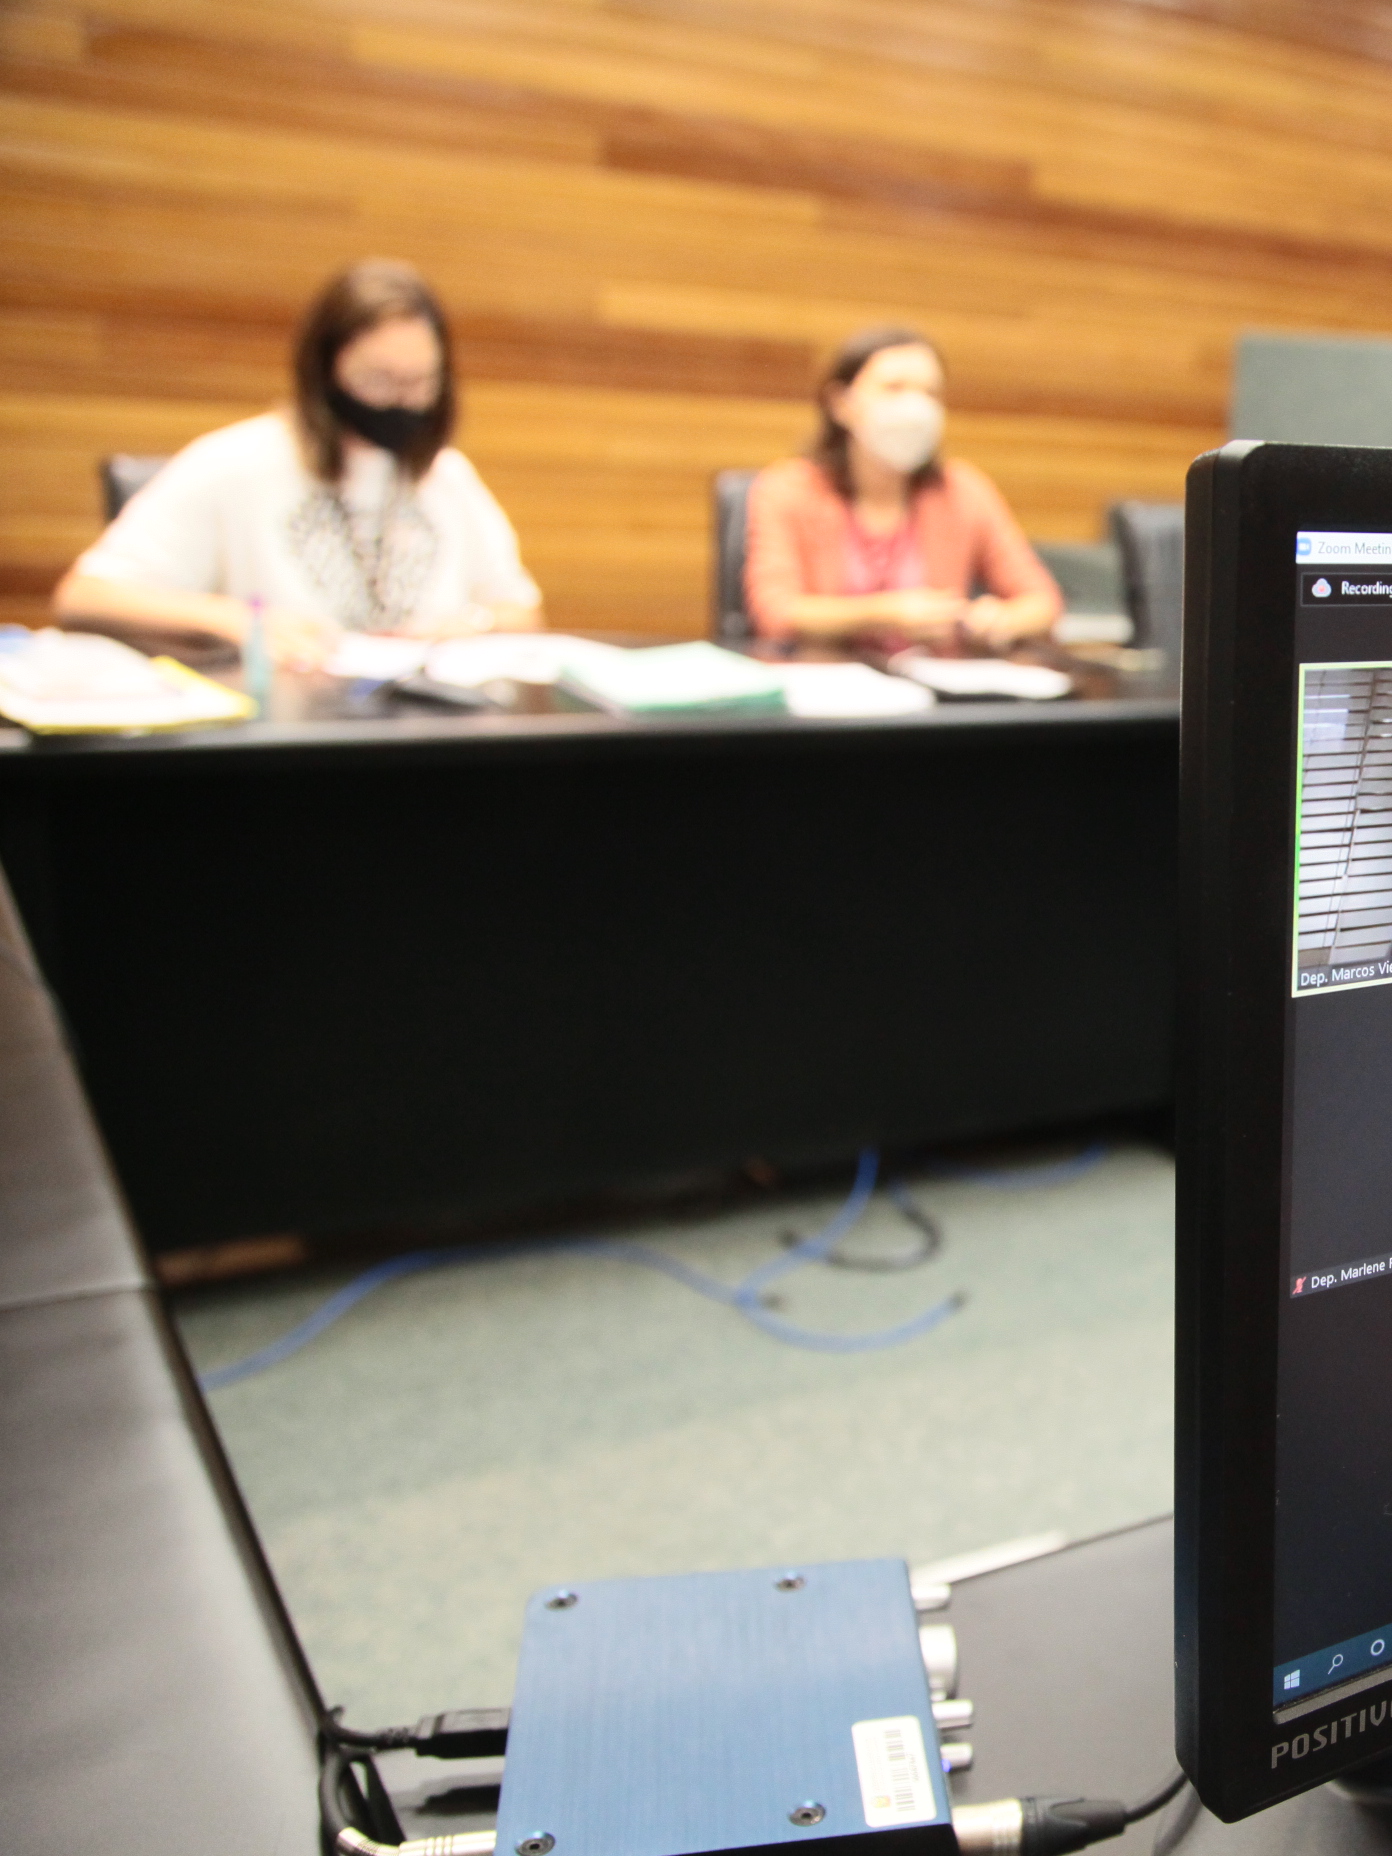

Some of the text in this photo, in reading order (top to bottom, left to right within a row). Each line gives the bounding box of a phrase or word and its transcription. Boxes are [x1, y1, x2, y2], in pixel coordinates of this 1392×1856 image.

[1318, 541, 1351, 554] Zoom
[1300, 972, 1328, 987] Dep.
[1331, 965, 1375, 982] Marcos
[1311, 1274, 1338, 1289] Dep.
[1340, 1261, 1386, 1281] Marlene
